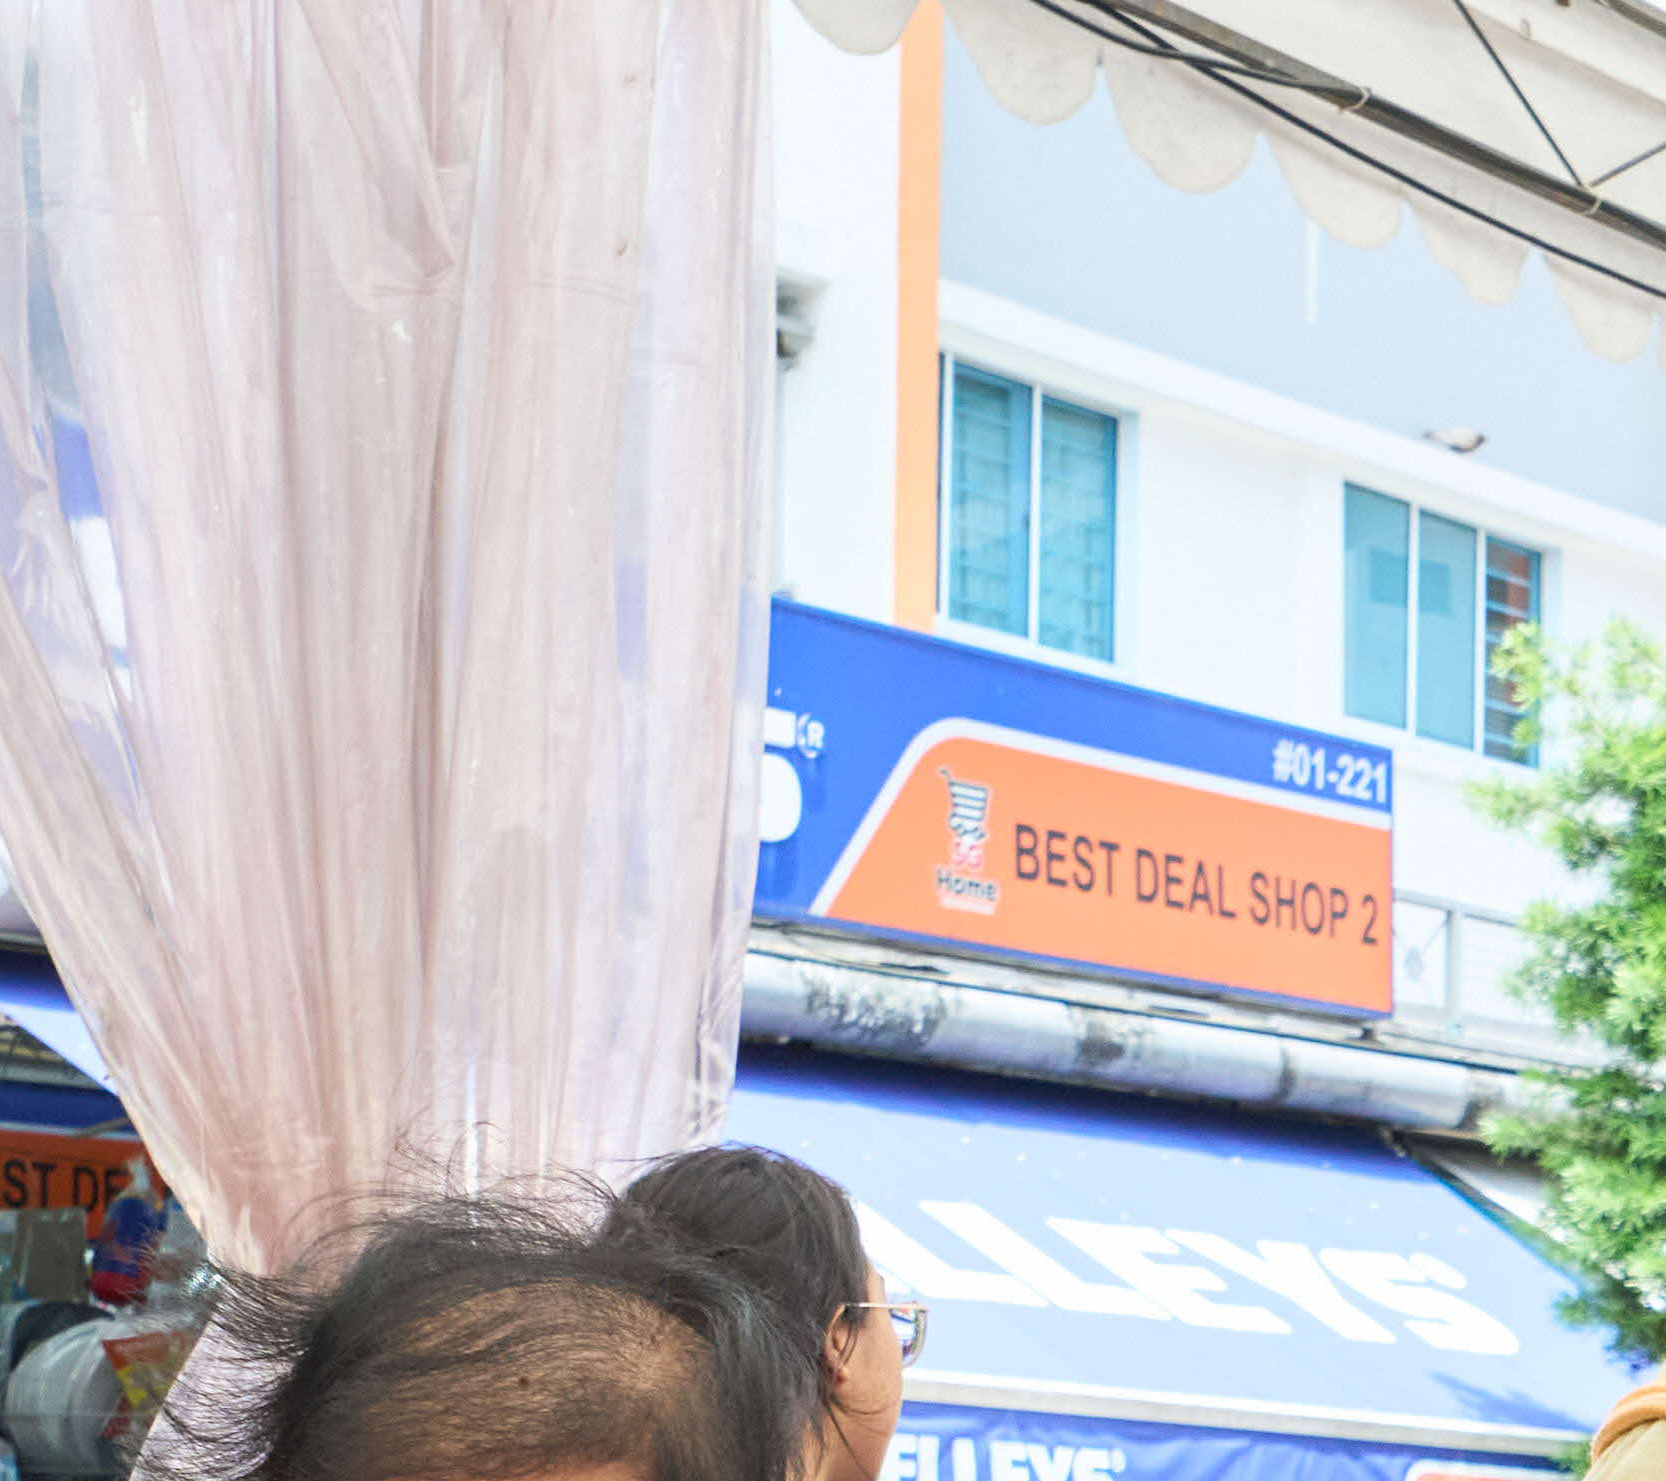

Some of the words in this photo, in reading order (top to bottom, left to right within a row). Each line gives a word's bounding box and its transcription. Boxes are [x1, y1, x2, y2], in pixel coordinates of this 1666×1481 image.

[1271, 738, 1388, 803] #01-221
[935, 867, 998, 902] Home
[1014, 823, 1120, 896] BEST
[1135, 848, 1237, 920] DEAL
[1249, 871, 1349, 938] SHOP
[1360, 894, 1379, 945] 2
